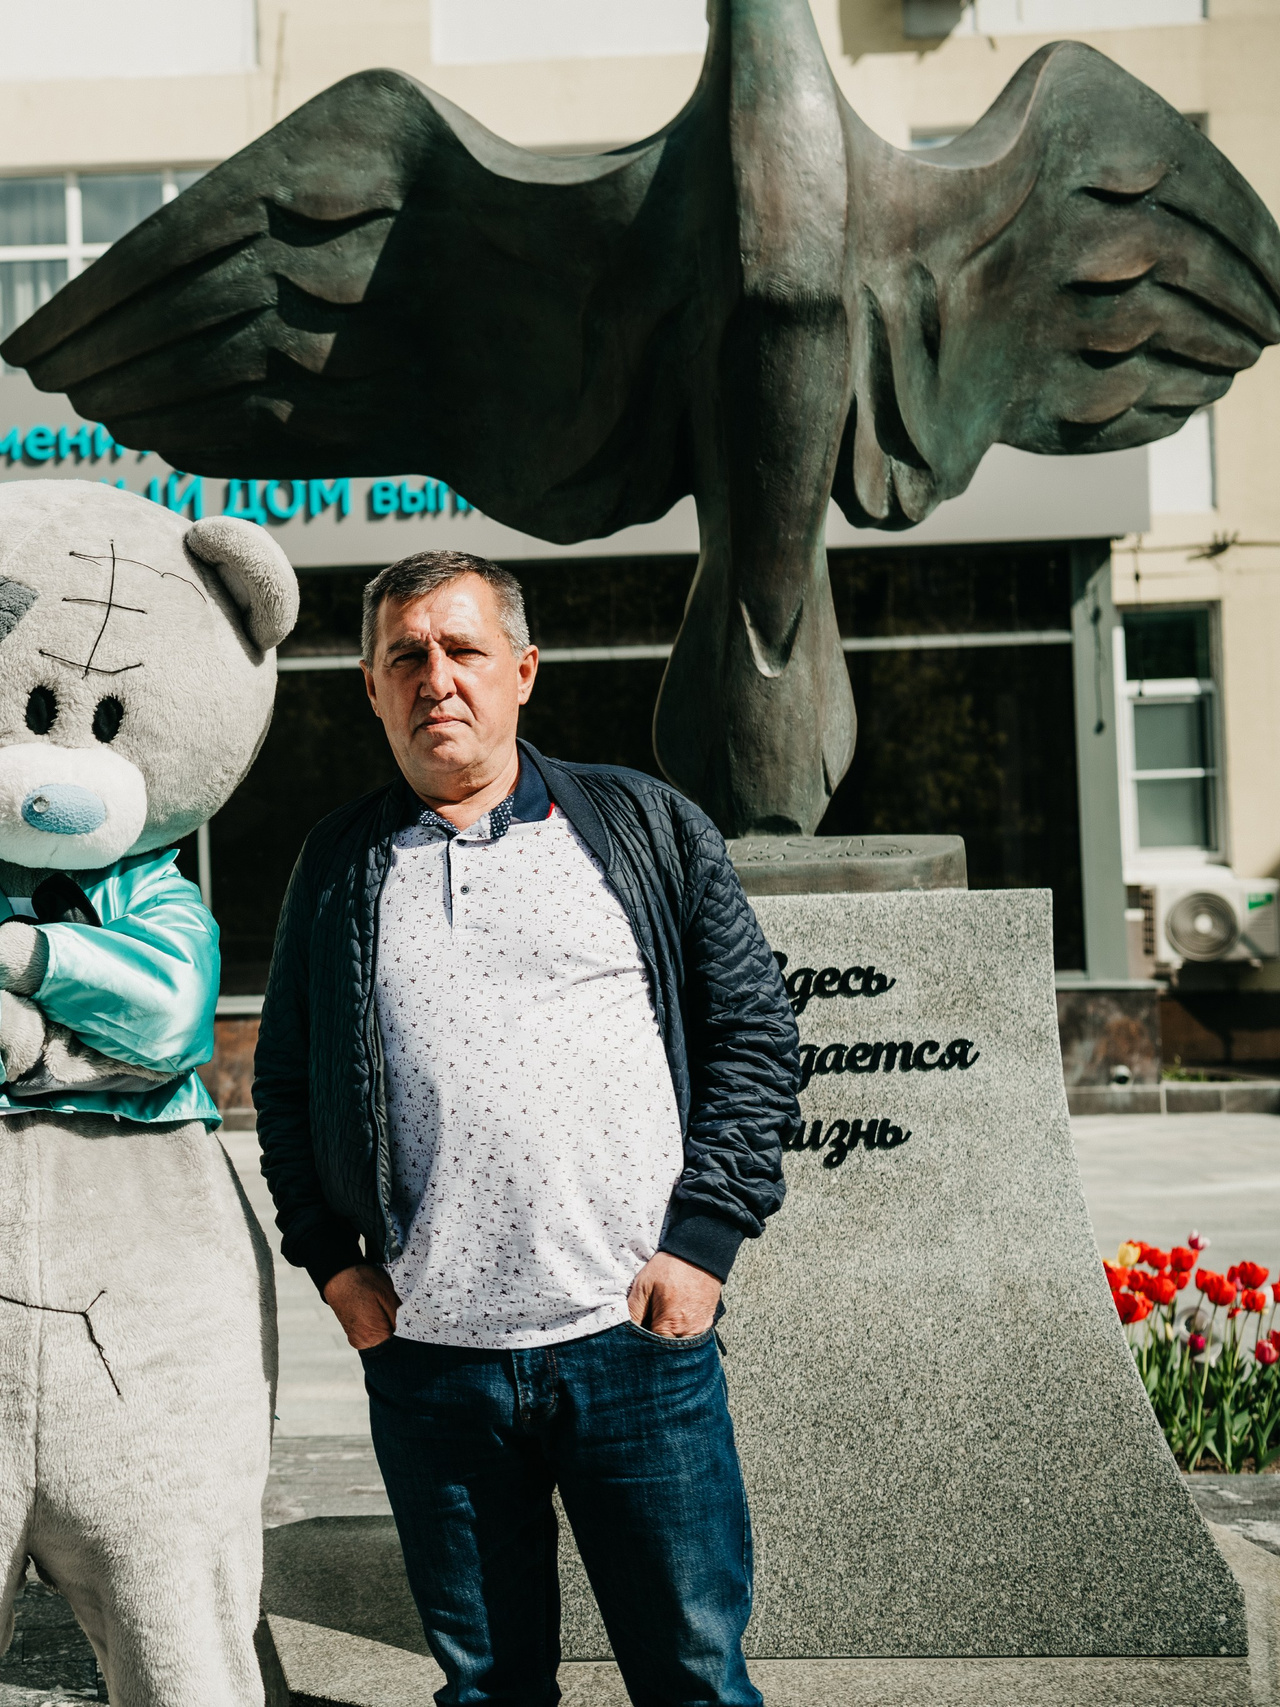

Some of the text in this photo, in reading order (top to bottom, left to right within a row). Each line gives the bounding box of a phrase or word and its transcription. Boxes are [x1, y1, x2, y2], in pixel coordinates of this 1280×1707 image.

[222, 477, 351, 526] ДОМ
[797, 1038, 980, 1093] дается
[782, 1118, 912, 1169] изнь
